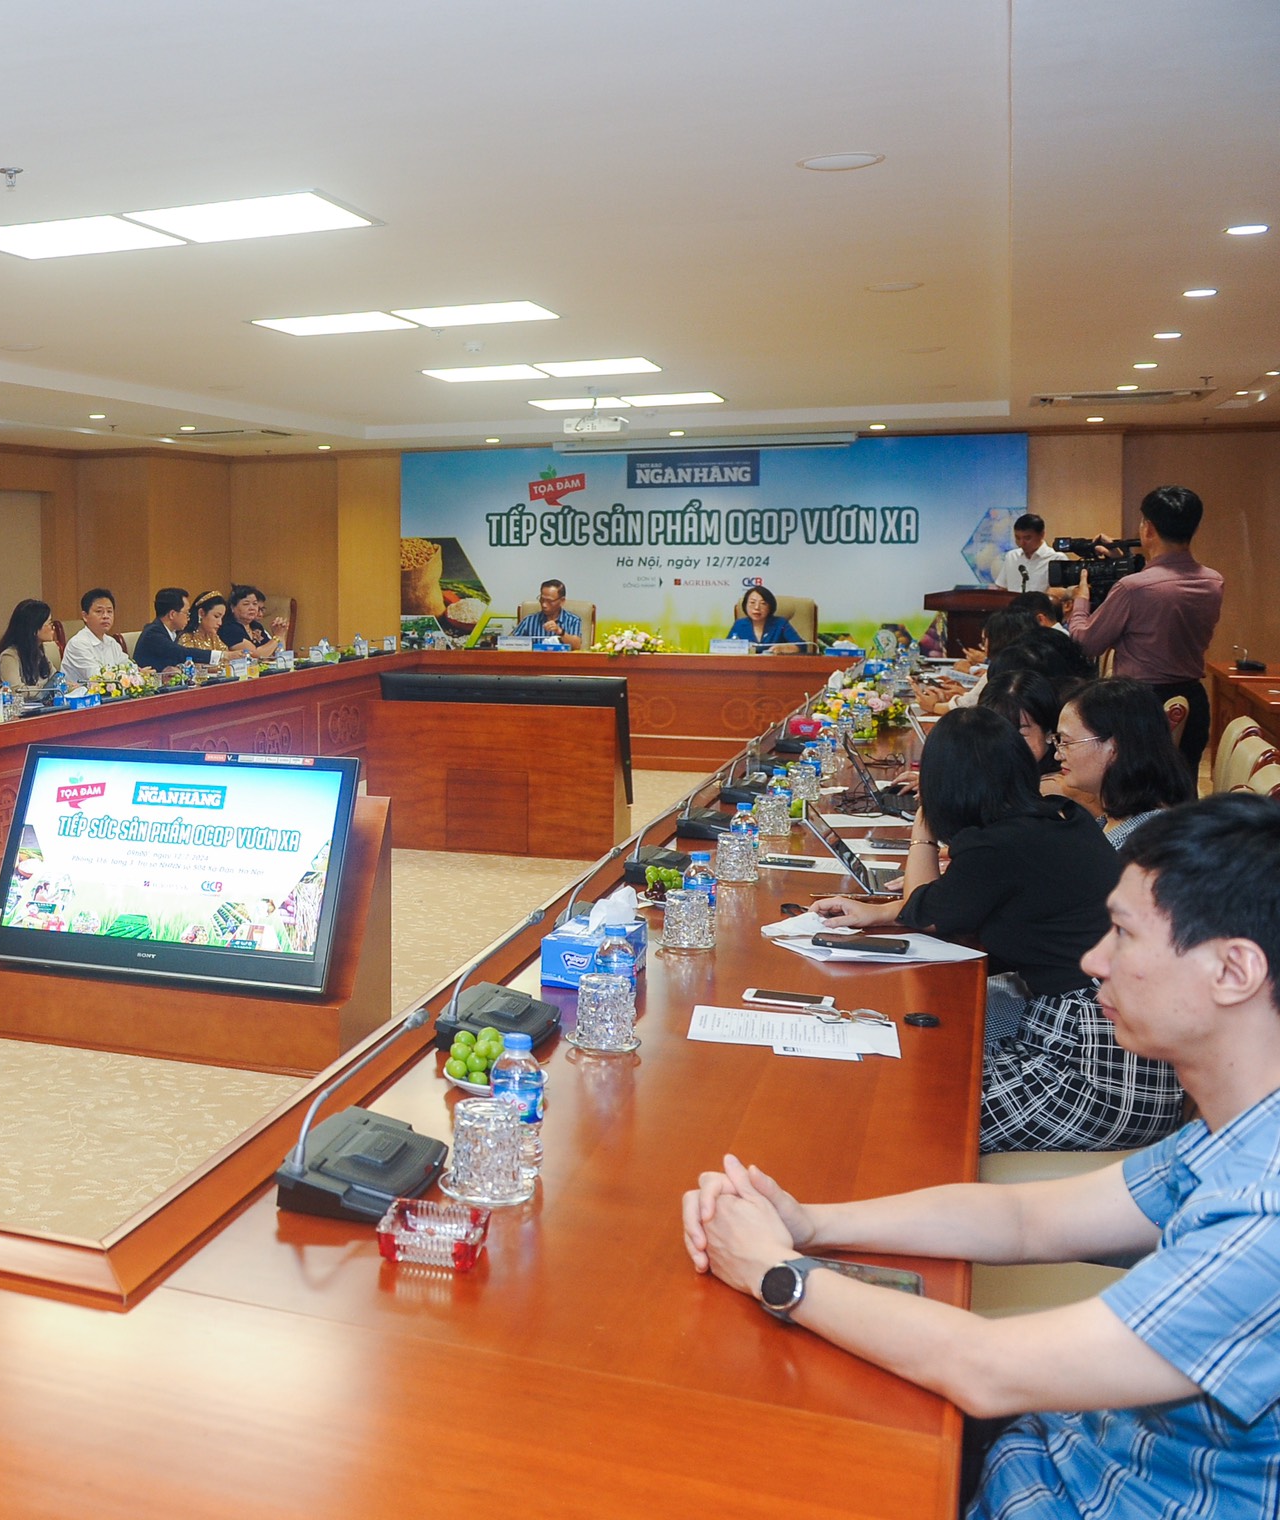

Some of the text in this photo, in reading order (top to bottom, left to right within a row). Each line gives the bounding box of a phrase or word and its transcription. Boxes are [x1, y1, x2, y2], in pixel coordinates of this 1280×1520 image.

[533, 479, 581, 496] TỌA ĐÀM
[486, 499, 919, 546] TIẾP SỨC SẢN PHẨM OCOP VƯƠN XA
[616, 556, 770, 570] Hà Nội, ngày 12/7/2024
[684, 579, 730, 587] AGRIBANK
[60, 786, 102, 799] TỌA ĐÀM
[58, 811, 301, 852] TIẾP SỨC SẢN PHẨM OCOP VƯƠN XA
